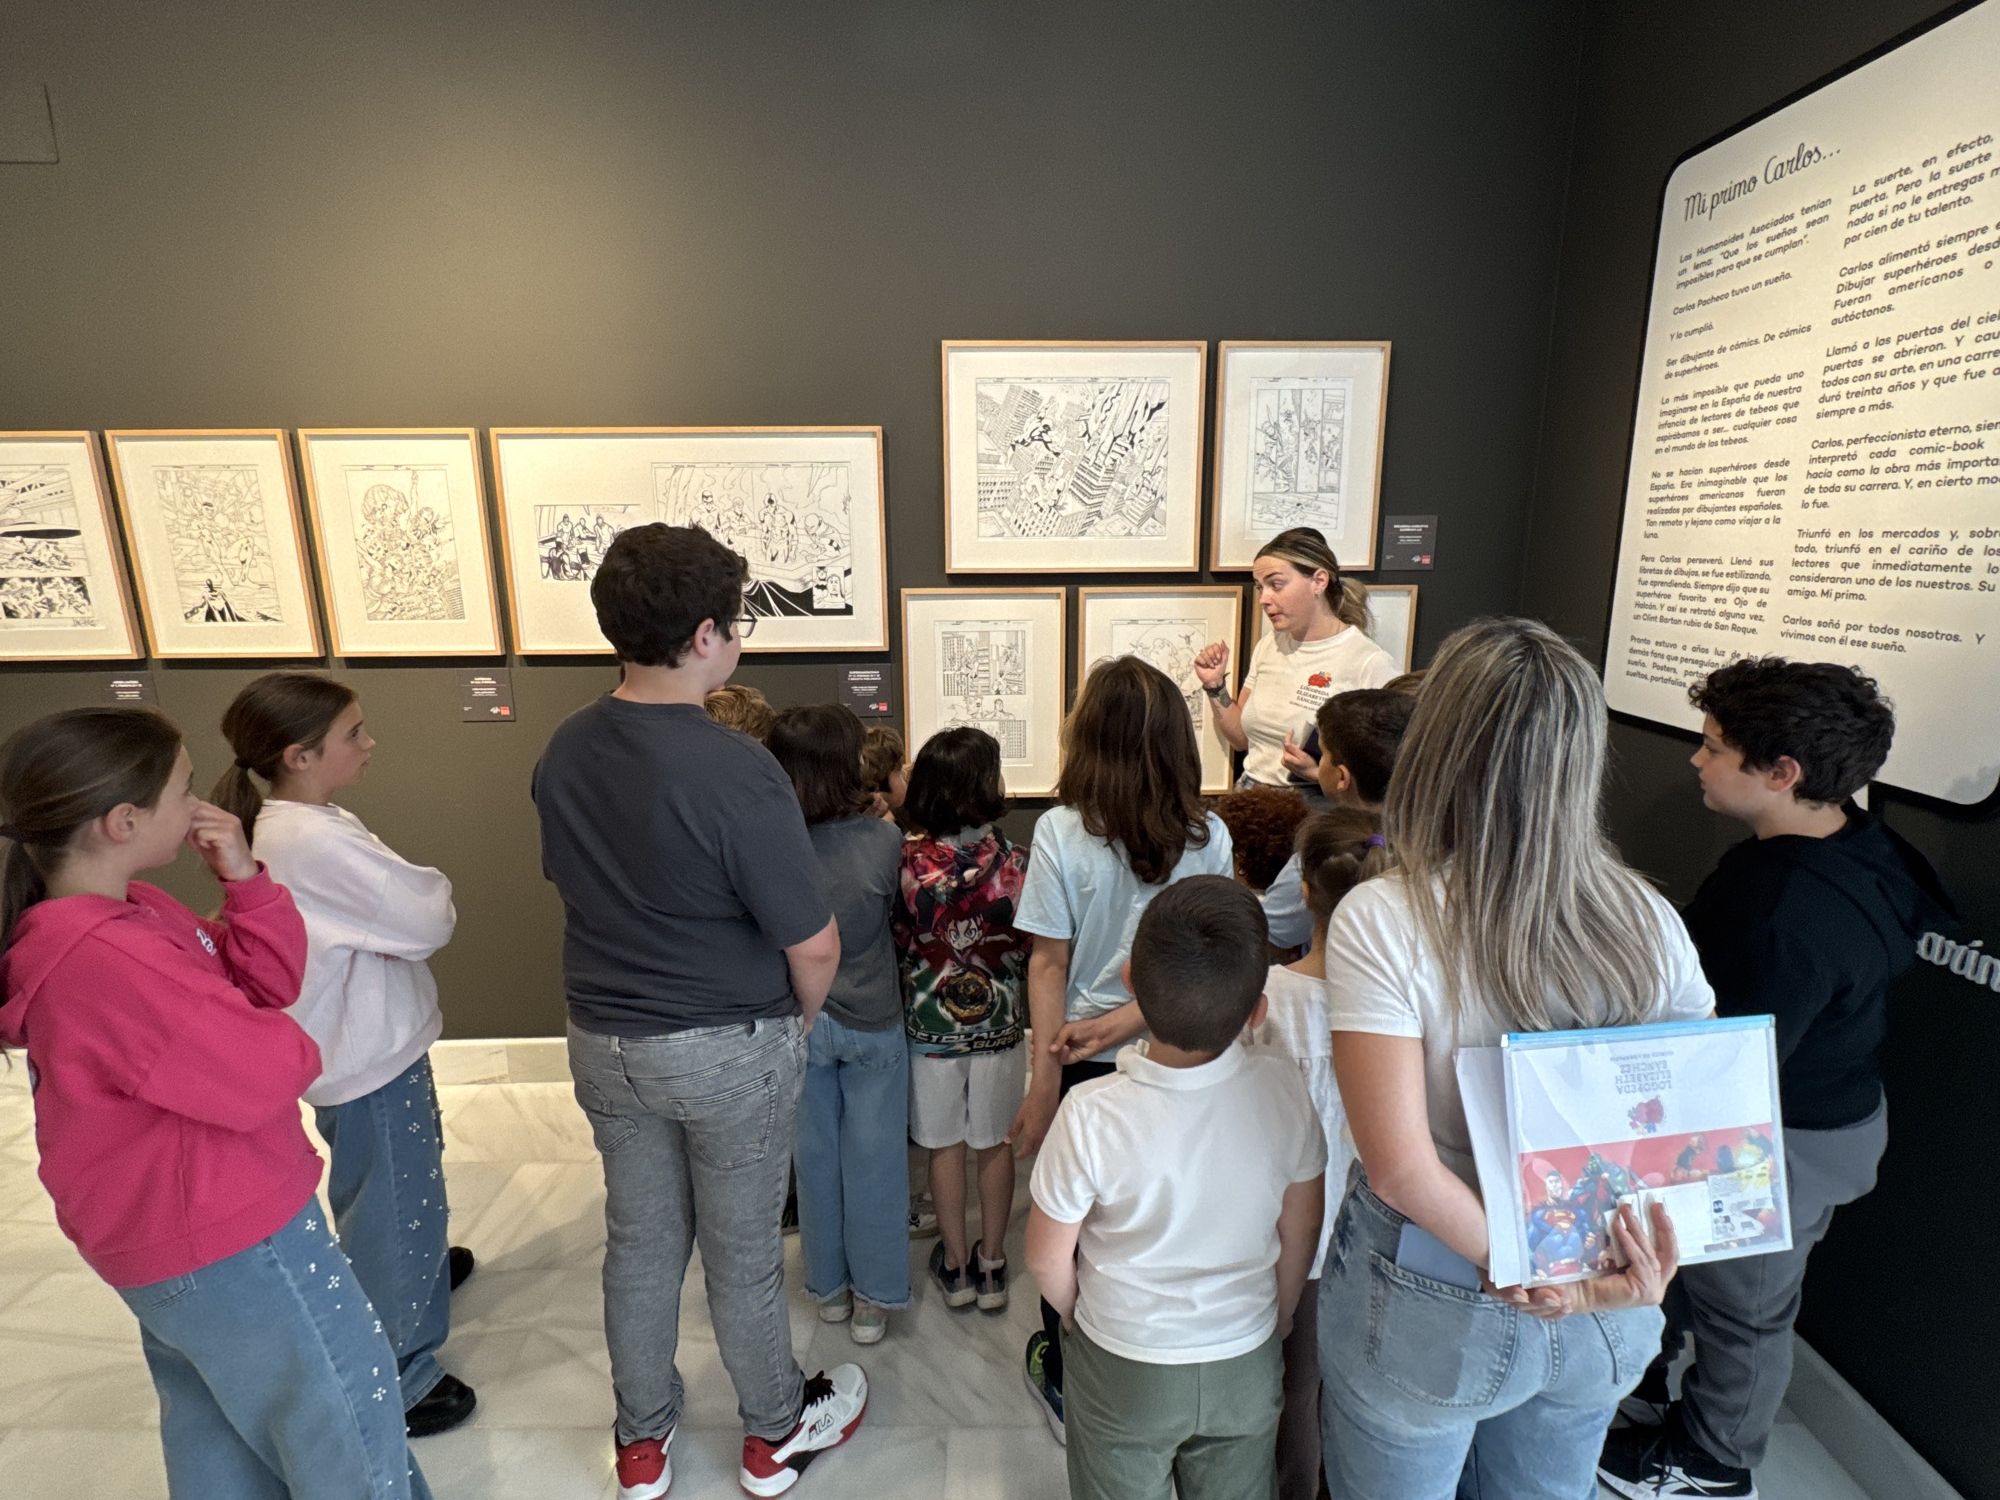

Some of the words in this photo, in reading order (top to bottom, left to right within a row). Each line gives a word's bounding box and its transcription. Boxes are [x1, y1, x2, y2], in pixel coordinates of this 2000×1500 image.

[1852, 184, 1866, 195] La
[1921, 156, 1937, 168] en
[1946, 134, 1993, 158] efecto,
[1684, 192, 1708, 222] Mi
[1708, 175, 1758, 221] primo
[1764, 142, 1841, 184] Carlos...
[1849, 192, 1888, 215] puerta.
[1895, 179, 1922, 195] Pero
[1929, 171, 1941, 182] la
[1948, 152, 1991, 175] suerte
[1846, 212, 1874, 229] nada
[1878, 205, 1888, 218] si
[1892, 201, 1907, 213] no
[1911, 195, 1921, 206] le
[1926, 172, 1984, 200] entregas
[1843, 233, 1862, 248] por
[1864, 224, 1887, 238] cien
[1890, 217, 1904, 229] de
[1908, 212, 1921, 223] tu
[1924, 195, 1973, 218] talento.
[1839, 261, 1873, 277] Carlos
[1878, 240, 1930, 265] alimentó
[1936, 225, 1989, 248] siempre
[1678, 268, 1687, 276] un
[1751, 281, 1762, 290] un
[1834, 293, 1871, 310] Fueran
[1888, 268, 1963, 295] americanos
[1984, 260, 1993, 269] o
[1836, 276, 1875, 294] Dibujar
[1883, 252, 1957, 280] superhéroes
[1831, 304, 1894, 326] autóctonos.
[1826, 341, 1857, 357] Llamó
[1862, 341, 1869, 349] a
[1875, 336, 1891, 347] las
[1896, 325, 1943, 345] puertas
[1950, 316, 1970, 330] del
[1823, 358, 1863, 376] puertas
[1872, 354, 1884, 363] se
[1893, 342, 1946, 359] abrieron.
[1955, 335, 1964, 347] Y
[1821, 376, 1849, 388] todos
[1851, 373, 1871, 383] con
[1874, 370, 1887, 379] su
[1919, 361, 1934, 371] en
[1937, 356, 1961, 368] una
[1818, 391, 1841, 404] duró
[1845, 386, 1883, 399] treinta
[1887, 381, 1915, 392] años
[1921, 379, 1929, 390] y
[1933, 374, 1957, 388] que
[1963, 368, 1986, 380] fue
[1816, 407, 1856, 419] siempre
[1858, 405, 1865, 413] a
[1868, 399, 1893, 412] más.
[1811, 438, 1844, 449] Carlos,
[1846, 428, 1926, 448] perfeccionista
[1929, 425, 1972, 437] eterno,
[1808, 450, 1857, 465] interpretó
[1869, 447, 1896, 459] cada
[1909, 438, 1984, 455] comic-book
[1806, 468, 1832, 479] hacía
[1836, 468, 1865, 477] como
[1869, 464, 1879, 474] la
[1884, 463, 1910, 474] obra
[1915, 460, 1941, 471] más
[1803, 484, 1815, 494] de
[1818, 483, 1841, 493] toda
[1844, 484, 1856, 492] su
[1859, 482, 1900, 491] carrera.
[1917, 480, 1931, 488] en
[1935, 475, 1972, 487] cierto
[1801, 499, 1809, 509] lo
[1811, 498, 1829, 508] fue.
[1797, 528, 1831, 538] Triunfó
[1838, 530, 1850, 538] en
[1858, 528, 1873, 538] los
[1881, 527, 1939, 538] mercados
[1825, 543, 1860, 553] triunfó
[1868, 546, 1882, 554] en
[1890, 544, 1900, 554] el
[1908, 544, 1947, 555] cariño
[1957, 544, 1973, 555] de
[1791, 558, 1830, 568] lectores
[1840, 561, 1860, 571] que
[1872, 559, 1972, 573] inmediatamente
[1987, 562, 2000, 574] lo
[1787, 587, 1817, 599] amigo.
[1820, 589, 1832, 598] Mi
[1834, 590, 1866, 601] primo.
[1789, 572, 1852, 584] consideraron
[1855, 577, 1875, 585] uno
[1878, 576, 1892, 586] de
[1895, 576, 1912, 587] los
[1915, 579, 1972, 590] nuestros.
[1977, 580, 1995, 592] Su
[1782, 615, 1812, 626] Carlos
[1816, 619, 1840, 629] soñó
[1845, 623, 1863, 633] por
[1868, 624, 1899, 635] todos
[1906, 629, 1962, 642] nosotros.
[1975, 633, 1985, 644] Y
[1818, 635, 1836, 643] con
[1850, 639, 1868, 648] ese
[1871, 641, 1906, 652] sueño.
[808, 1413, 834, 1441] FILA
